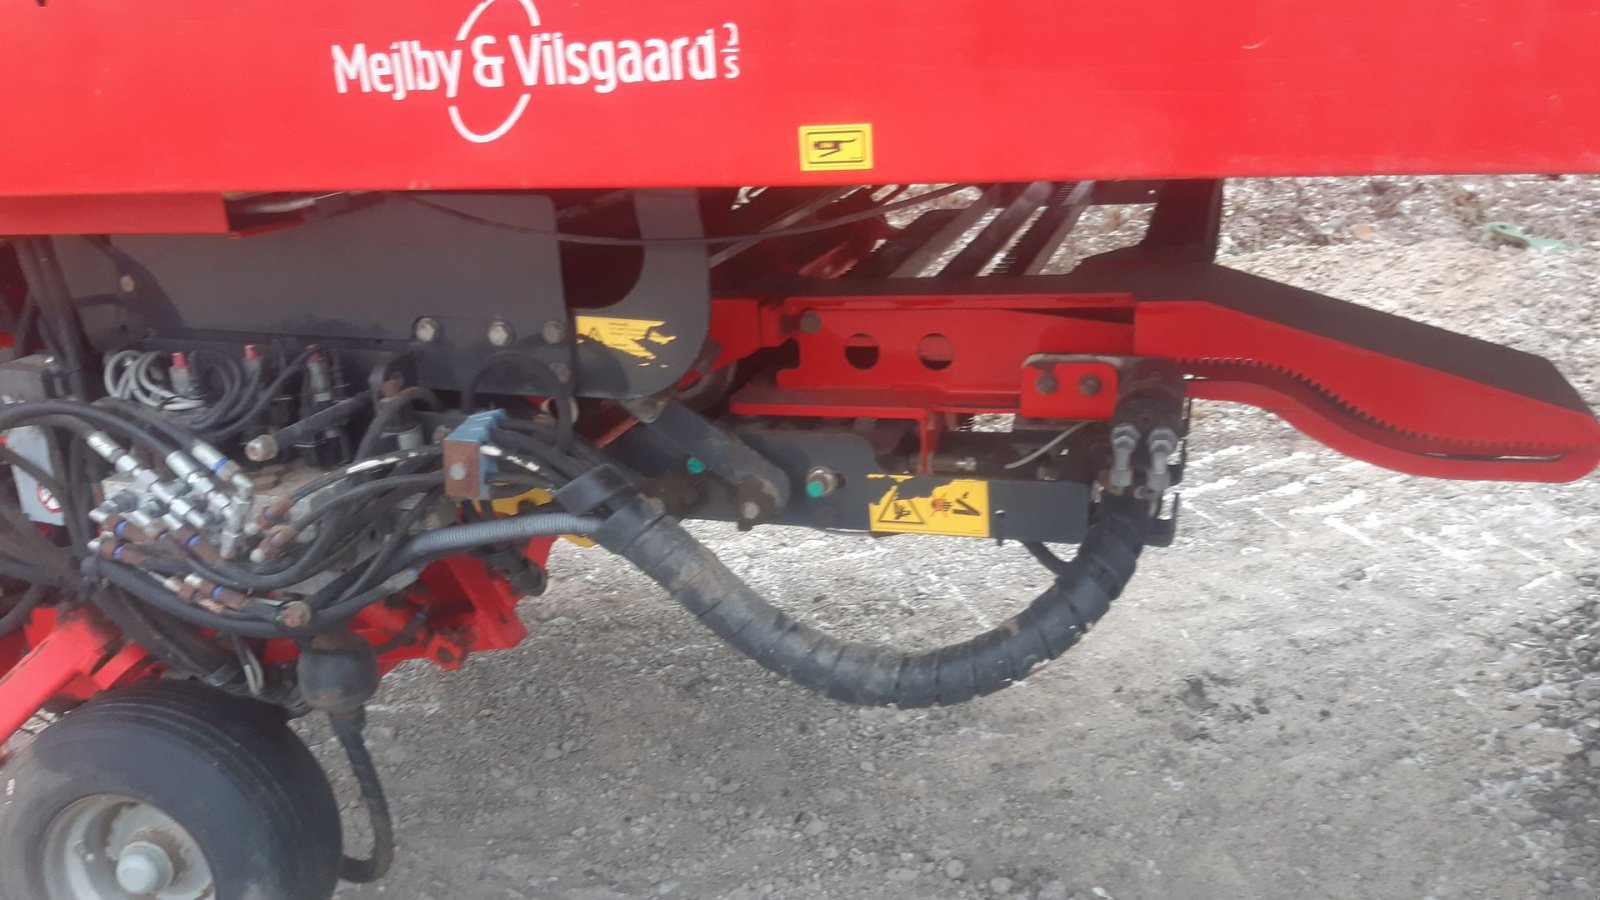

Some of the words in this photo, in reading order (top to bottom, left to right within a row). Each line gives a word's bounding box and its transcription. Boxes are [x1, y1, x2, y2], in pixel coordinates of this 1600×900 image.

[331, 40, 462, 100] Mejlby
[471, 35, 505, 87] &
[508, 28, 717, 93] Vilsgaard
